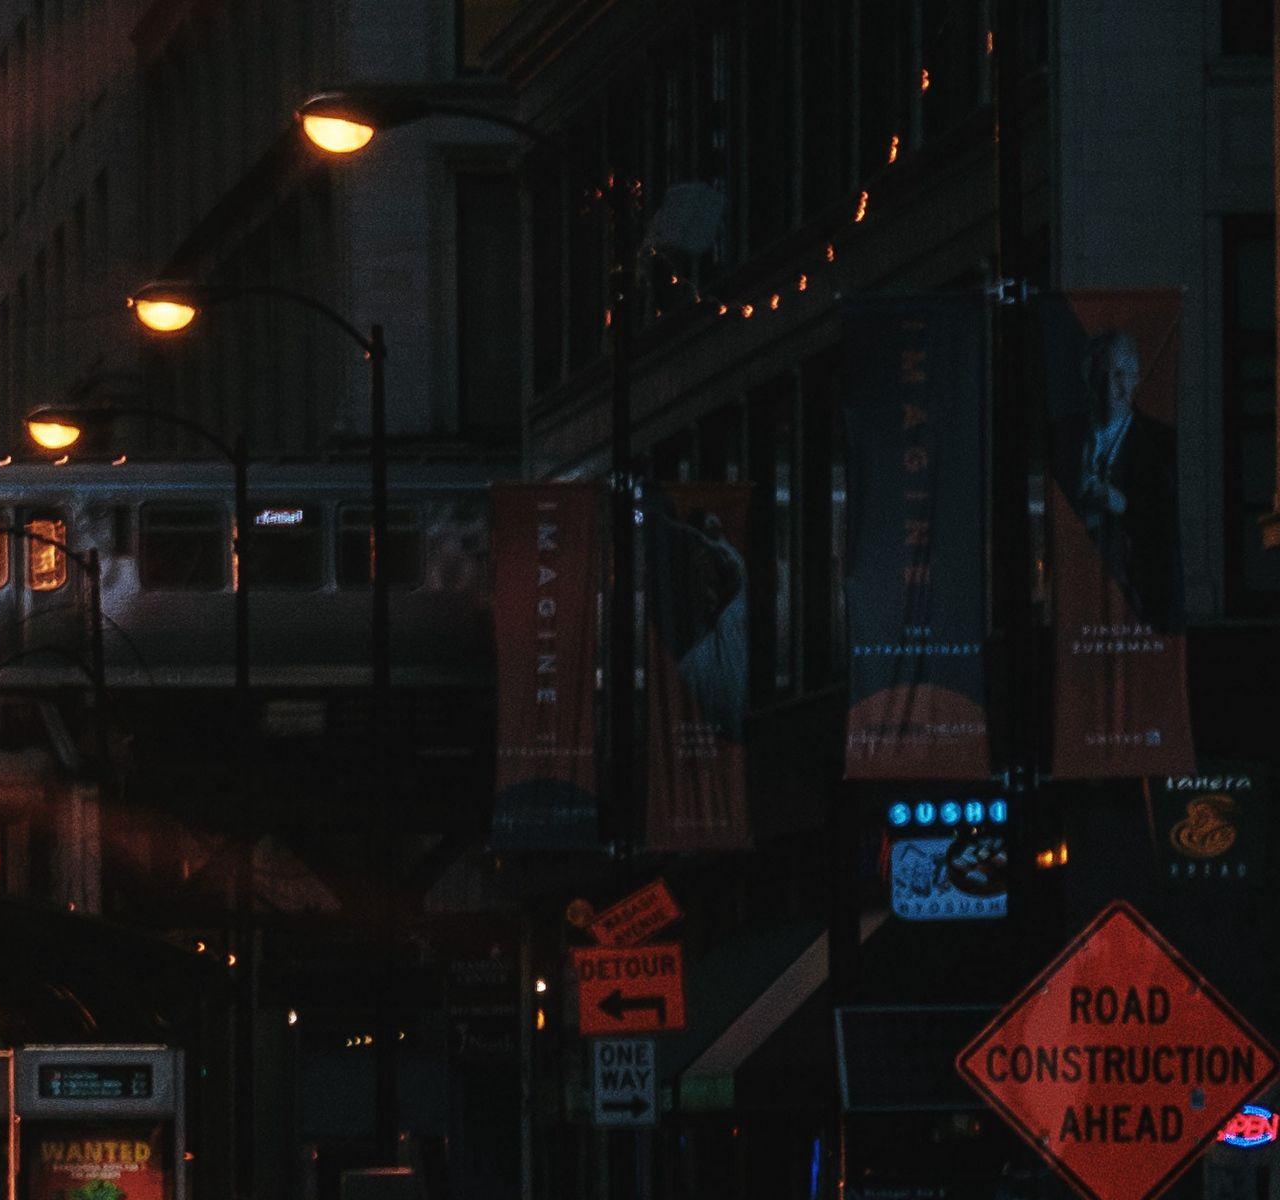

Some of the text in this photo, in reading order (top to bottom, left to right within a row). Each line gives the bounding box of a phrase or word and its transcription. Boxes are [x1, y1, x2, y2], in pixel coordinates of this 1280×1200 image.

[899, 320, 928, 586] IMAGINE
[536, 501, 557, 704] IMAGINE
[851, 644, 982, 657] EXTRAORDINARY
[888, 798, 1007, 829] SUSHI
[579, 955, 676, 981] DETOUR
[1069, 985, 1171, 1025] ROAD
[600, 1044, 649, 1067] ONE
[985, 1045, 1256, 1084] CONSTRUCTION
[603, 1069, 651, 1090] WAY
[1058, 1104, 1184, 1143] AHEAD
[40, 1140, 151, 1164] WANTED
